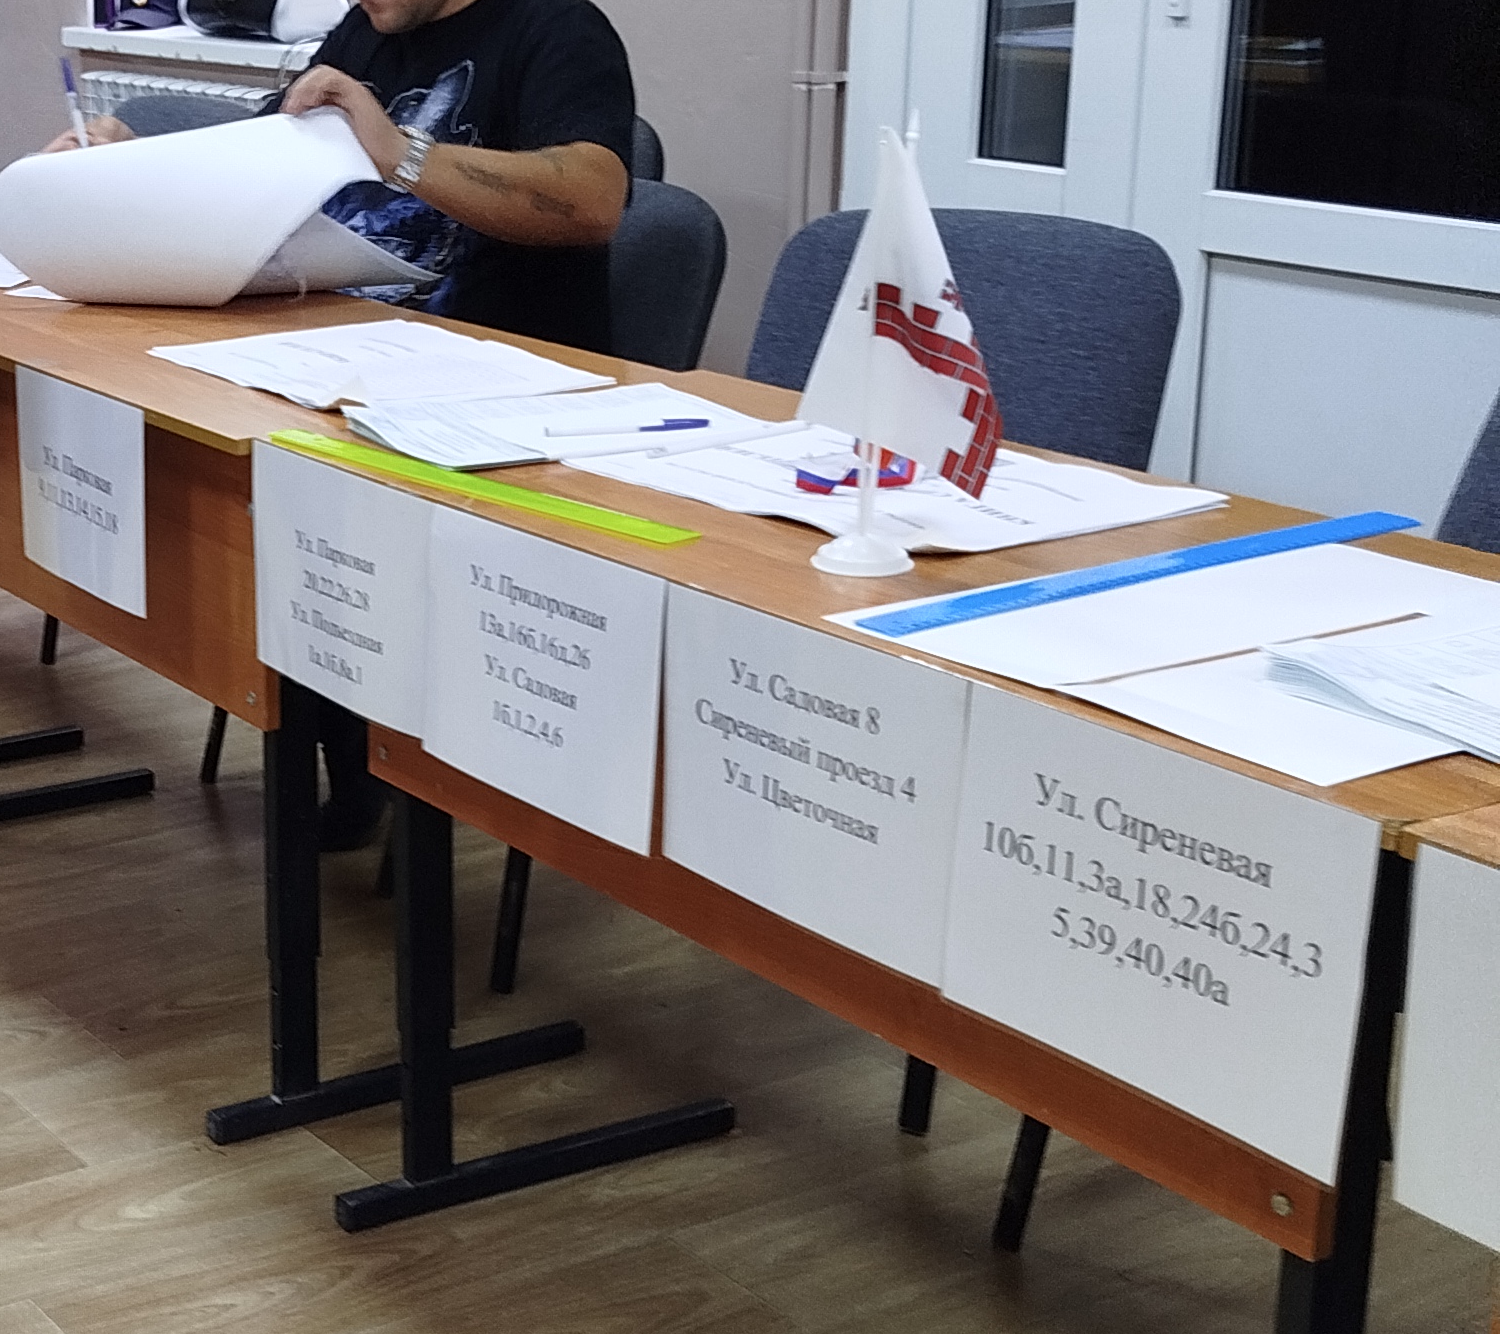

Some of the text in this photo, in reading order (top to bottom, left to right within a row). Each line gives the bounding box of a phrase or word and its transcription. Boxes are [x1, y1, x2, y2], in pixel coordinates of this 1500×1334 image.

[295, 529, 376, 576] Ул. Парковая
[290, 600, 311, 625] Ул.
[470, 563, 608, 632] Ул. Придорожная
[484, 653, 578, 711] Ул. Садовая
[729, 658, 882, 736] Ул. Садовая 8
[695, 698, 918, 804] Сиреневый проезд 4
[723, 758, 879, 845] Ул. Цветочная
[1034, 772, 1275, 889] Ул. Сиреневая
[1051, 906, 1231, 1007] 5,39,40,40а
